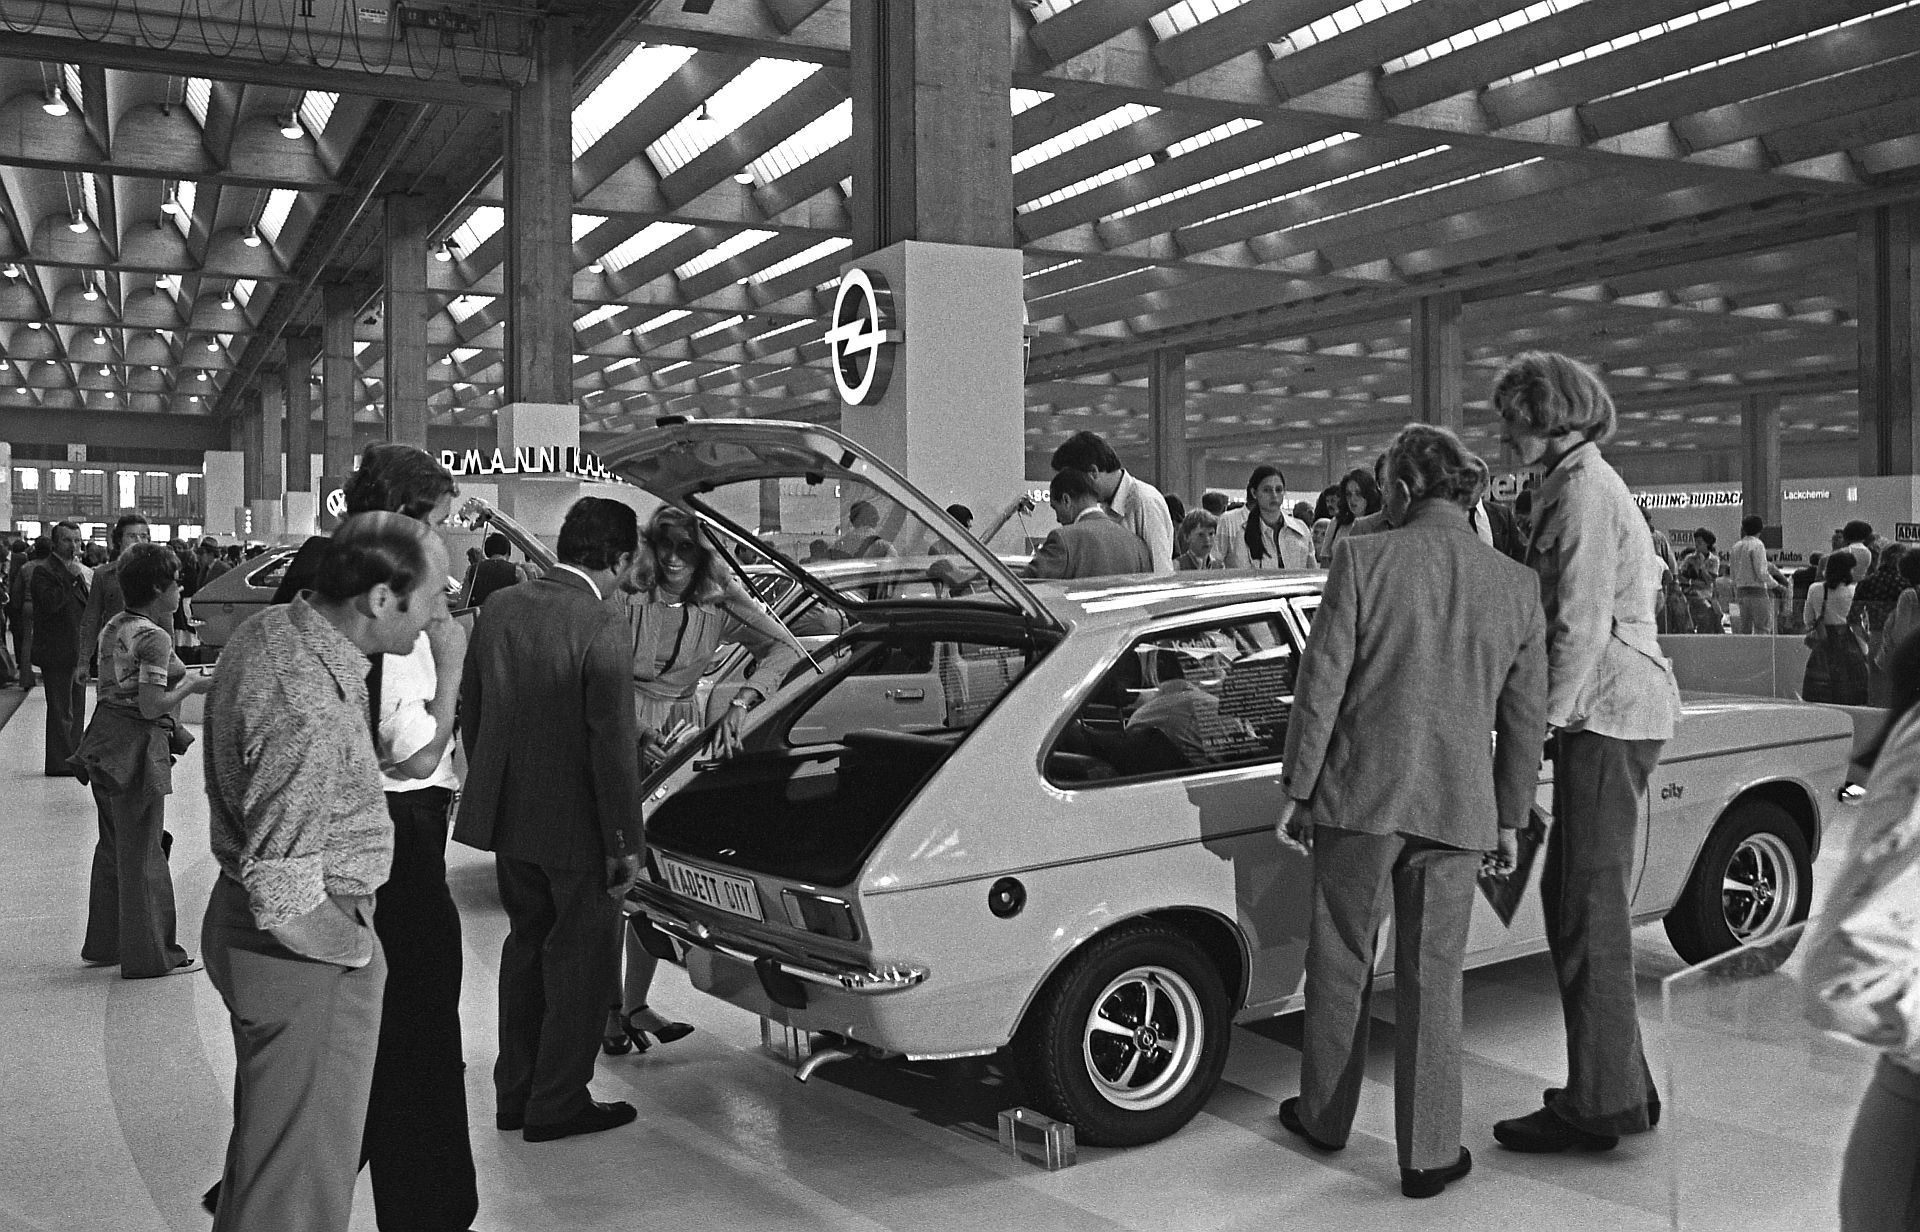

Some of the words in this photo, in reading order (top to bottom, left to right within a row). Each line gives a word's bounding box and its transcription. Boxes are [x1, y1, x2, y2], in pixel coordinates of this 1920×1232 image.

[441, 446, 558, 476] RMANN
[1783, 489, 1830, 500] Lackchemie
[1898, 525, 1920, 540] ADA
[1779, 551, 1803, 562] Autos
[1661, 782, 1683, 800] city
[667, 862, 721, 905] KADETT
[724, 881, 752, 914] CITY
